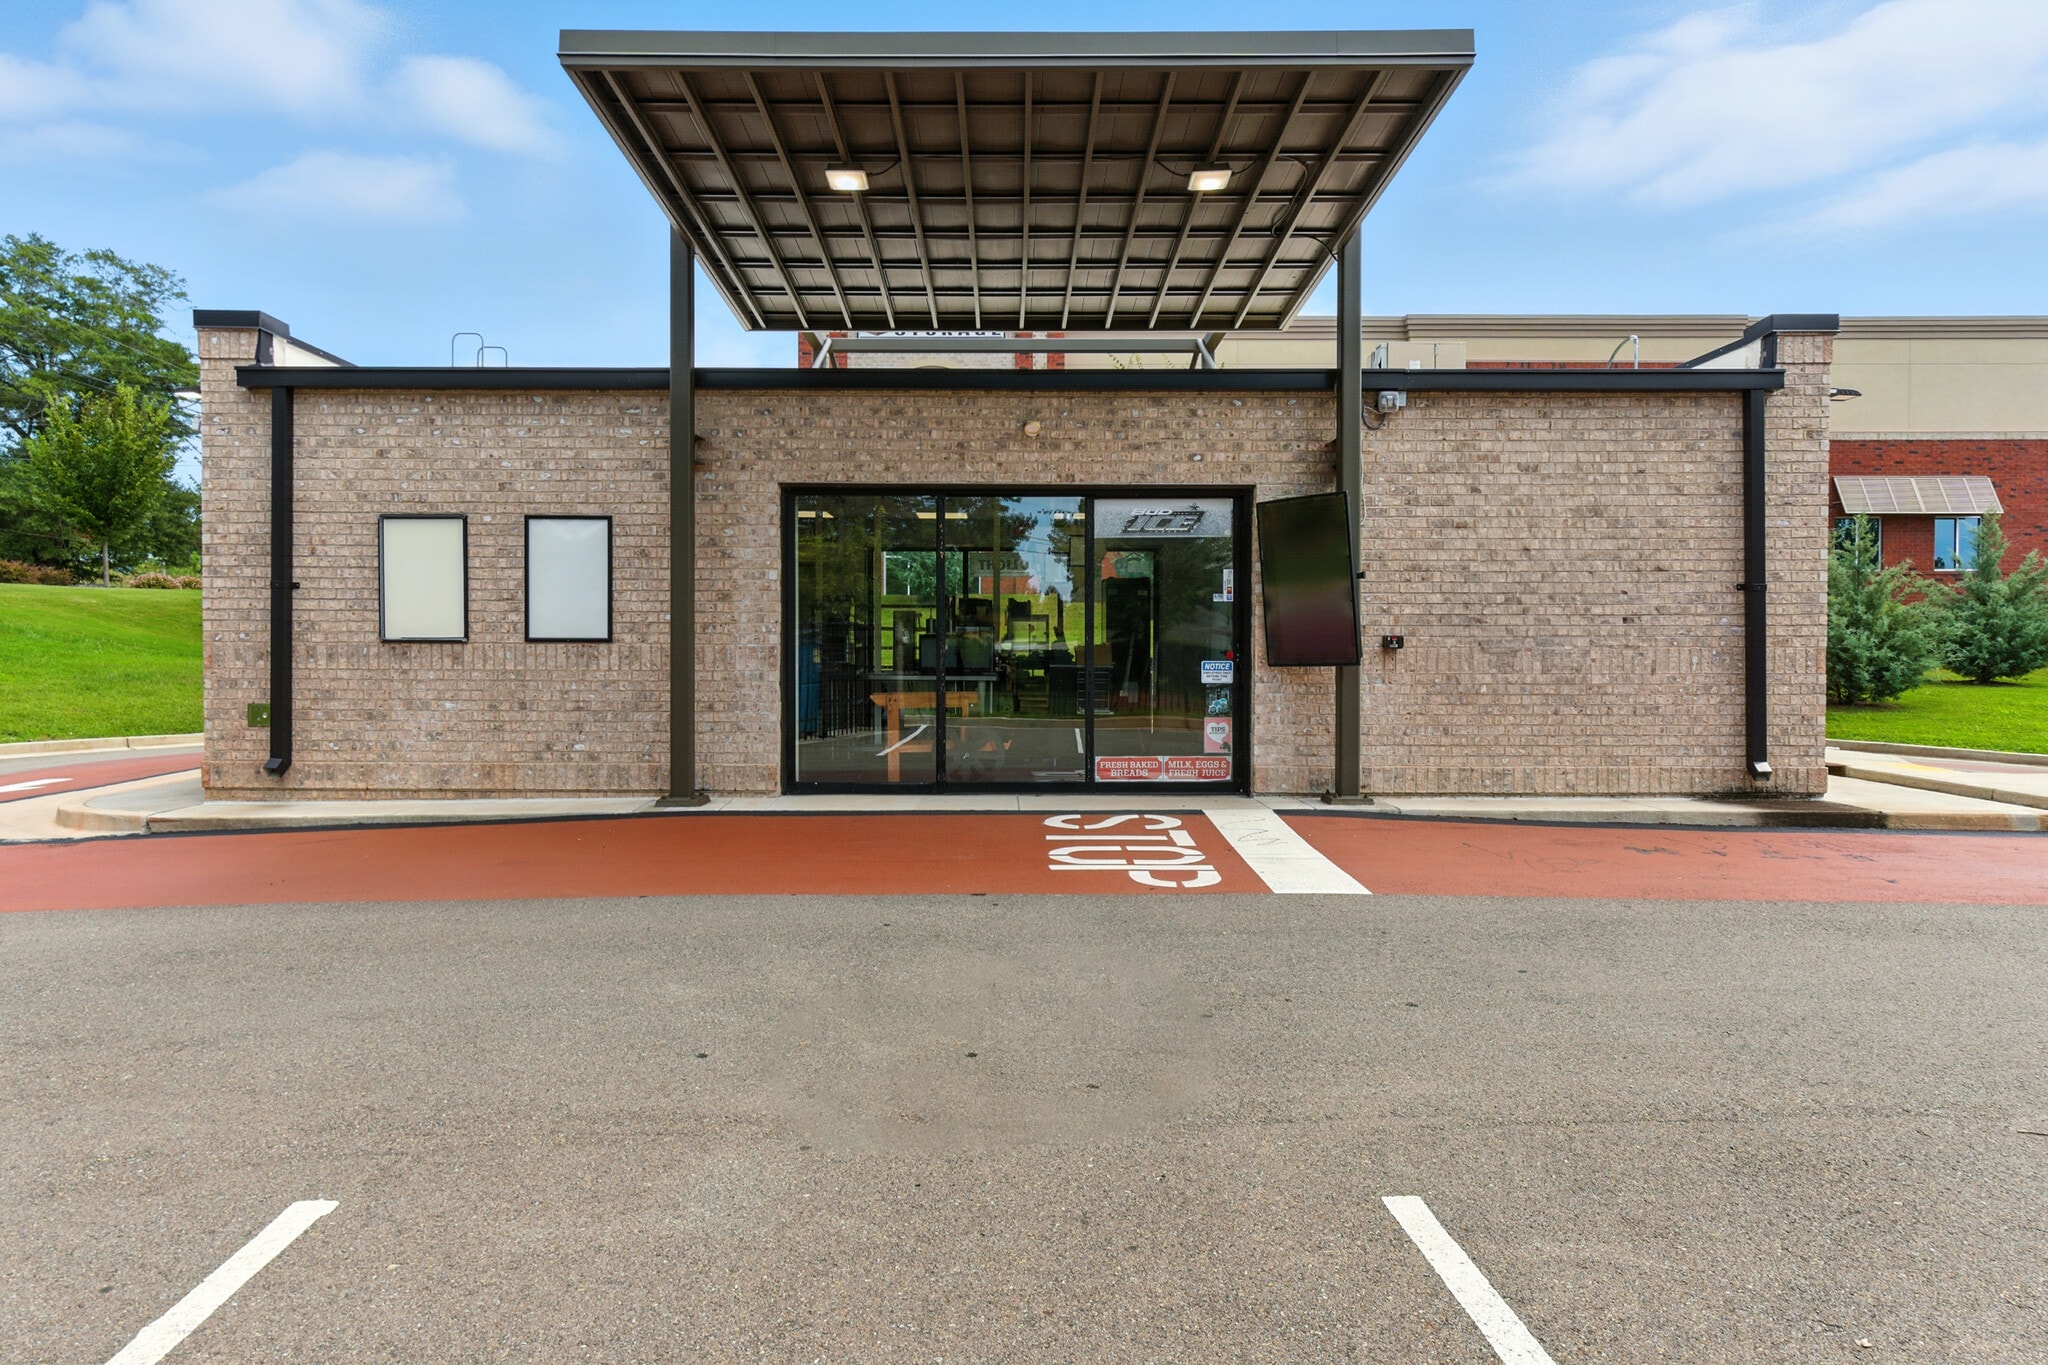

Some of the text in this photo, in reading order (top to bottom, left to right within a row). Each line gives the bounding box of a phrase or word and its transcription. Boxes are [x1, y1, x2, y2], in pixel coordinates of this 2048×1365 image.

[1126, 515, 1200, 532] ICE
[1100, 761, 1159, 769] FRESH BAKED
[1168, 760, 1227, 769] MILK, EGGS &
[1110, 769, 1148, 777] BREADS
[1169, 769, 1227, 777] FRESH JUICE
[1043, 814, 1222, 888] STOP
